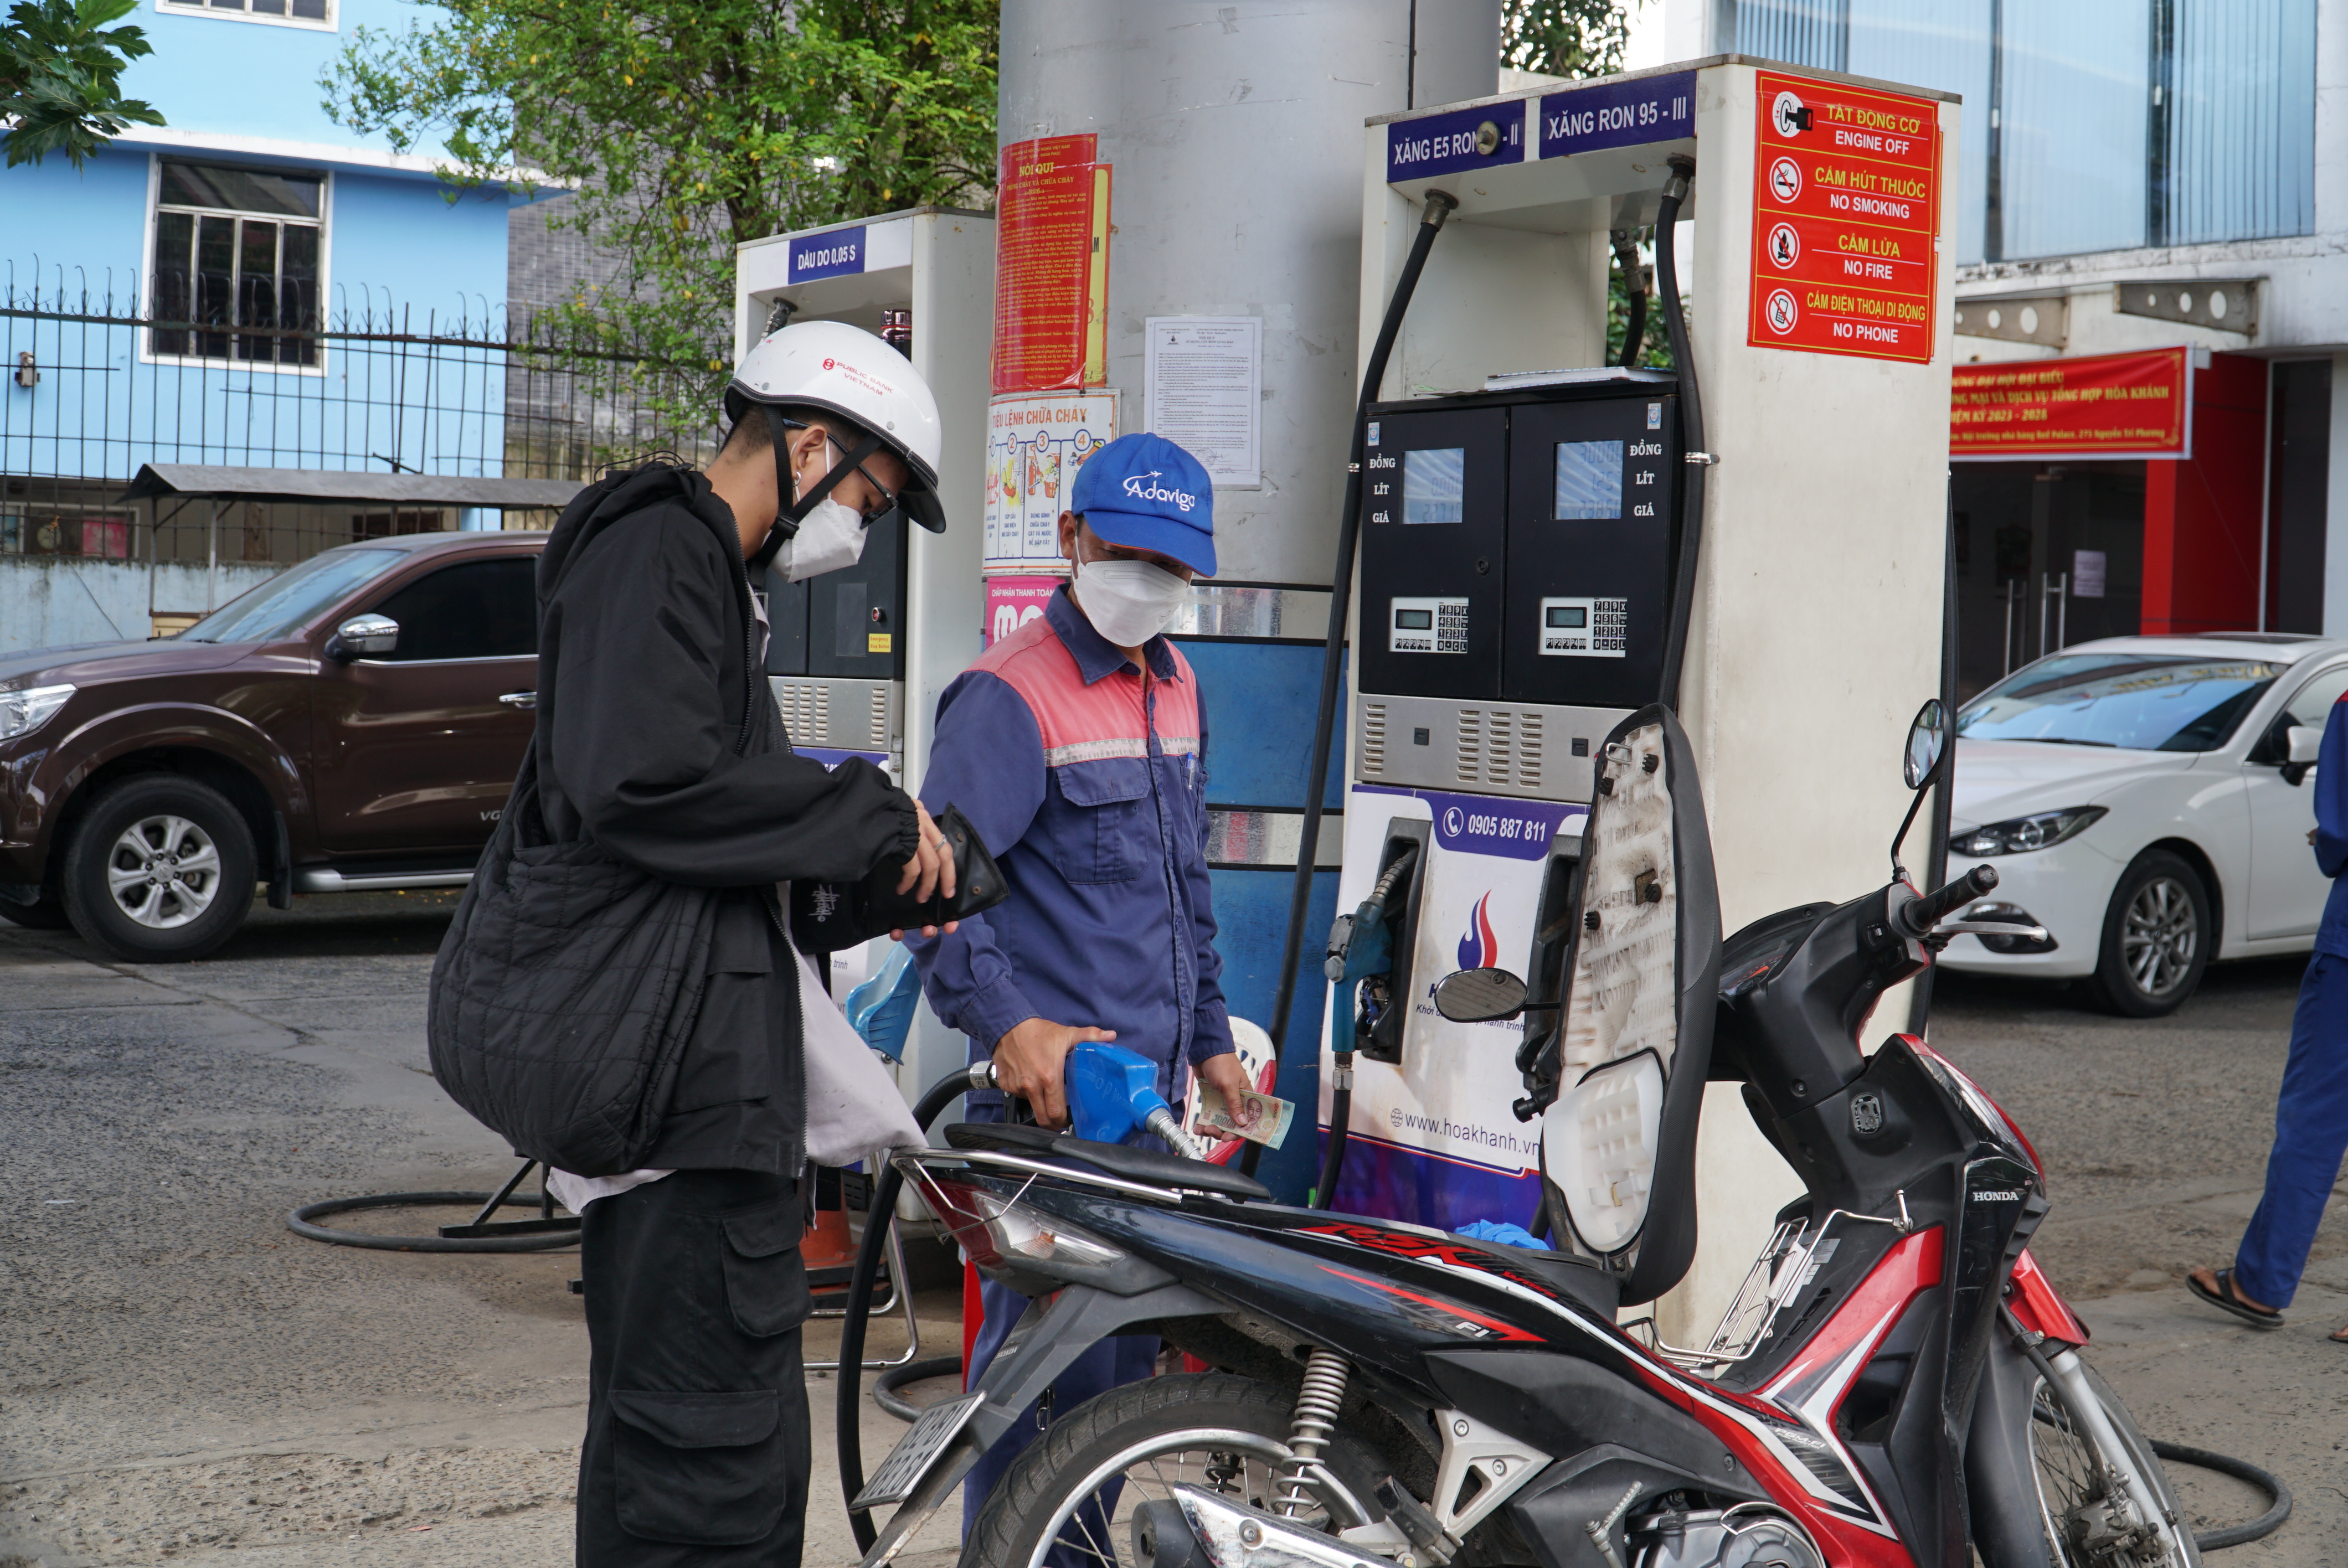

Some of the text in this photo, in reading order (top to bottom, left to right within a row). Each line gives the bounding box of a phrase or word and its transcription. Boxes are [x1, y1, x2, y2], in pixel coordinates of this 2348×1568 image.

[1548, 110, 1594, 140] XĂNG
[1598, 105, 1638, 131] RON
[1639, 101, 1658, 126] 95
[1672, 96, 1687, 121] III
[1826, 103, 1920, 133] TẮT ĐỘNG CƠ
[1394, 137, 1430, 164] XĂNG
[1433, 136, 1449, 158] E5
[1511, 123, 1518, 145] II
[1835, 130, 1910, 155] ENGINE OFF
[1018, 162, 1054, 178] NỘI QUI
[1019, 180, 1031, 189] CHÁY
[1032, 177, 1039, 186] VÀ
[1041, 177, 1057, 185] CHỮA
[1815, 165, 1926, 198] CẤM HÚT THUỐC
[1830, 194, 1910, 219] NO SMOKING
[1839, 233, 1901, 257] CẤM LỬA
[797, 244, 856, 270] DẦU DO 0,05 S
[1844, 260, 1893, 280] NO FIRE
[1807, 290, 1925, 323] CẤM ĐIỆN THOẠI DI ĐỘNG
[1834, 323, 1898, 343] NO PHONE
[836, 362, 893, 394] PUBLIC BANK
[844, 373, 883, 396] VIETNAM
[2131, 383, 2169, 400] KHÁNH
[992, 405, 1088, 429] TIÊU LỆNH CHỮA CHÁY
[1987, 409, 2013, 422] 2023
[2022, 408, 2048, 421] 2028
[1010, 437, 1015, 449] 2
[1039, 435, 1045, 447] 3
[1078, 434, 1086, 446] 4
[1630, 439, 1662, 456] ĐỒNG
[1369, 453, 1396, 468] ĐỒNG
[1636, 470, 1655, 484] LÍT
[1373, 482, 1389, 495] LÍT
[1372, 510, 1390, 523] GIÁ
[1634, 502, 1655, 517] GIÁ
[992, 586, 1055, 598] CHẤP NHẬN THANH TOÁN
[1468, 814, 1546, 842] 0905 887 811
[1405, 1113, 1539, 1156] www.hoakhanh.vn
[1973, 1192, 2019, 1201] HONDA
[1455, 1321, 1490, 1338] FI
[902, 1402, 967, 1451] 92-B1
[1774, 1427, 1826, 1448] PGM-FI
[1791, 1438, 1820, 1450] INJECTION
